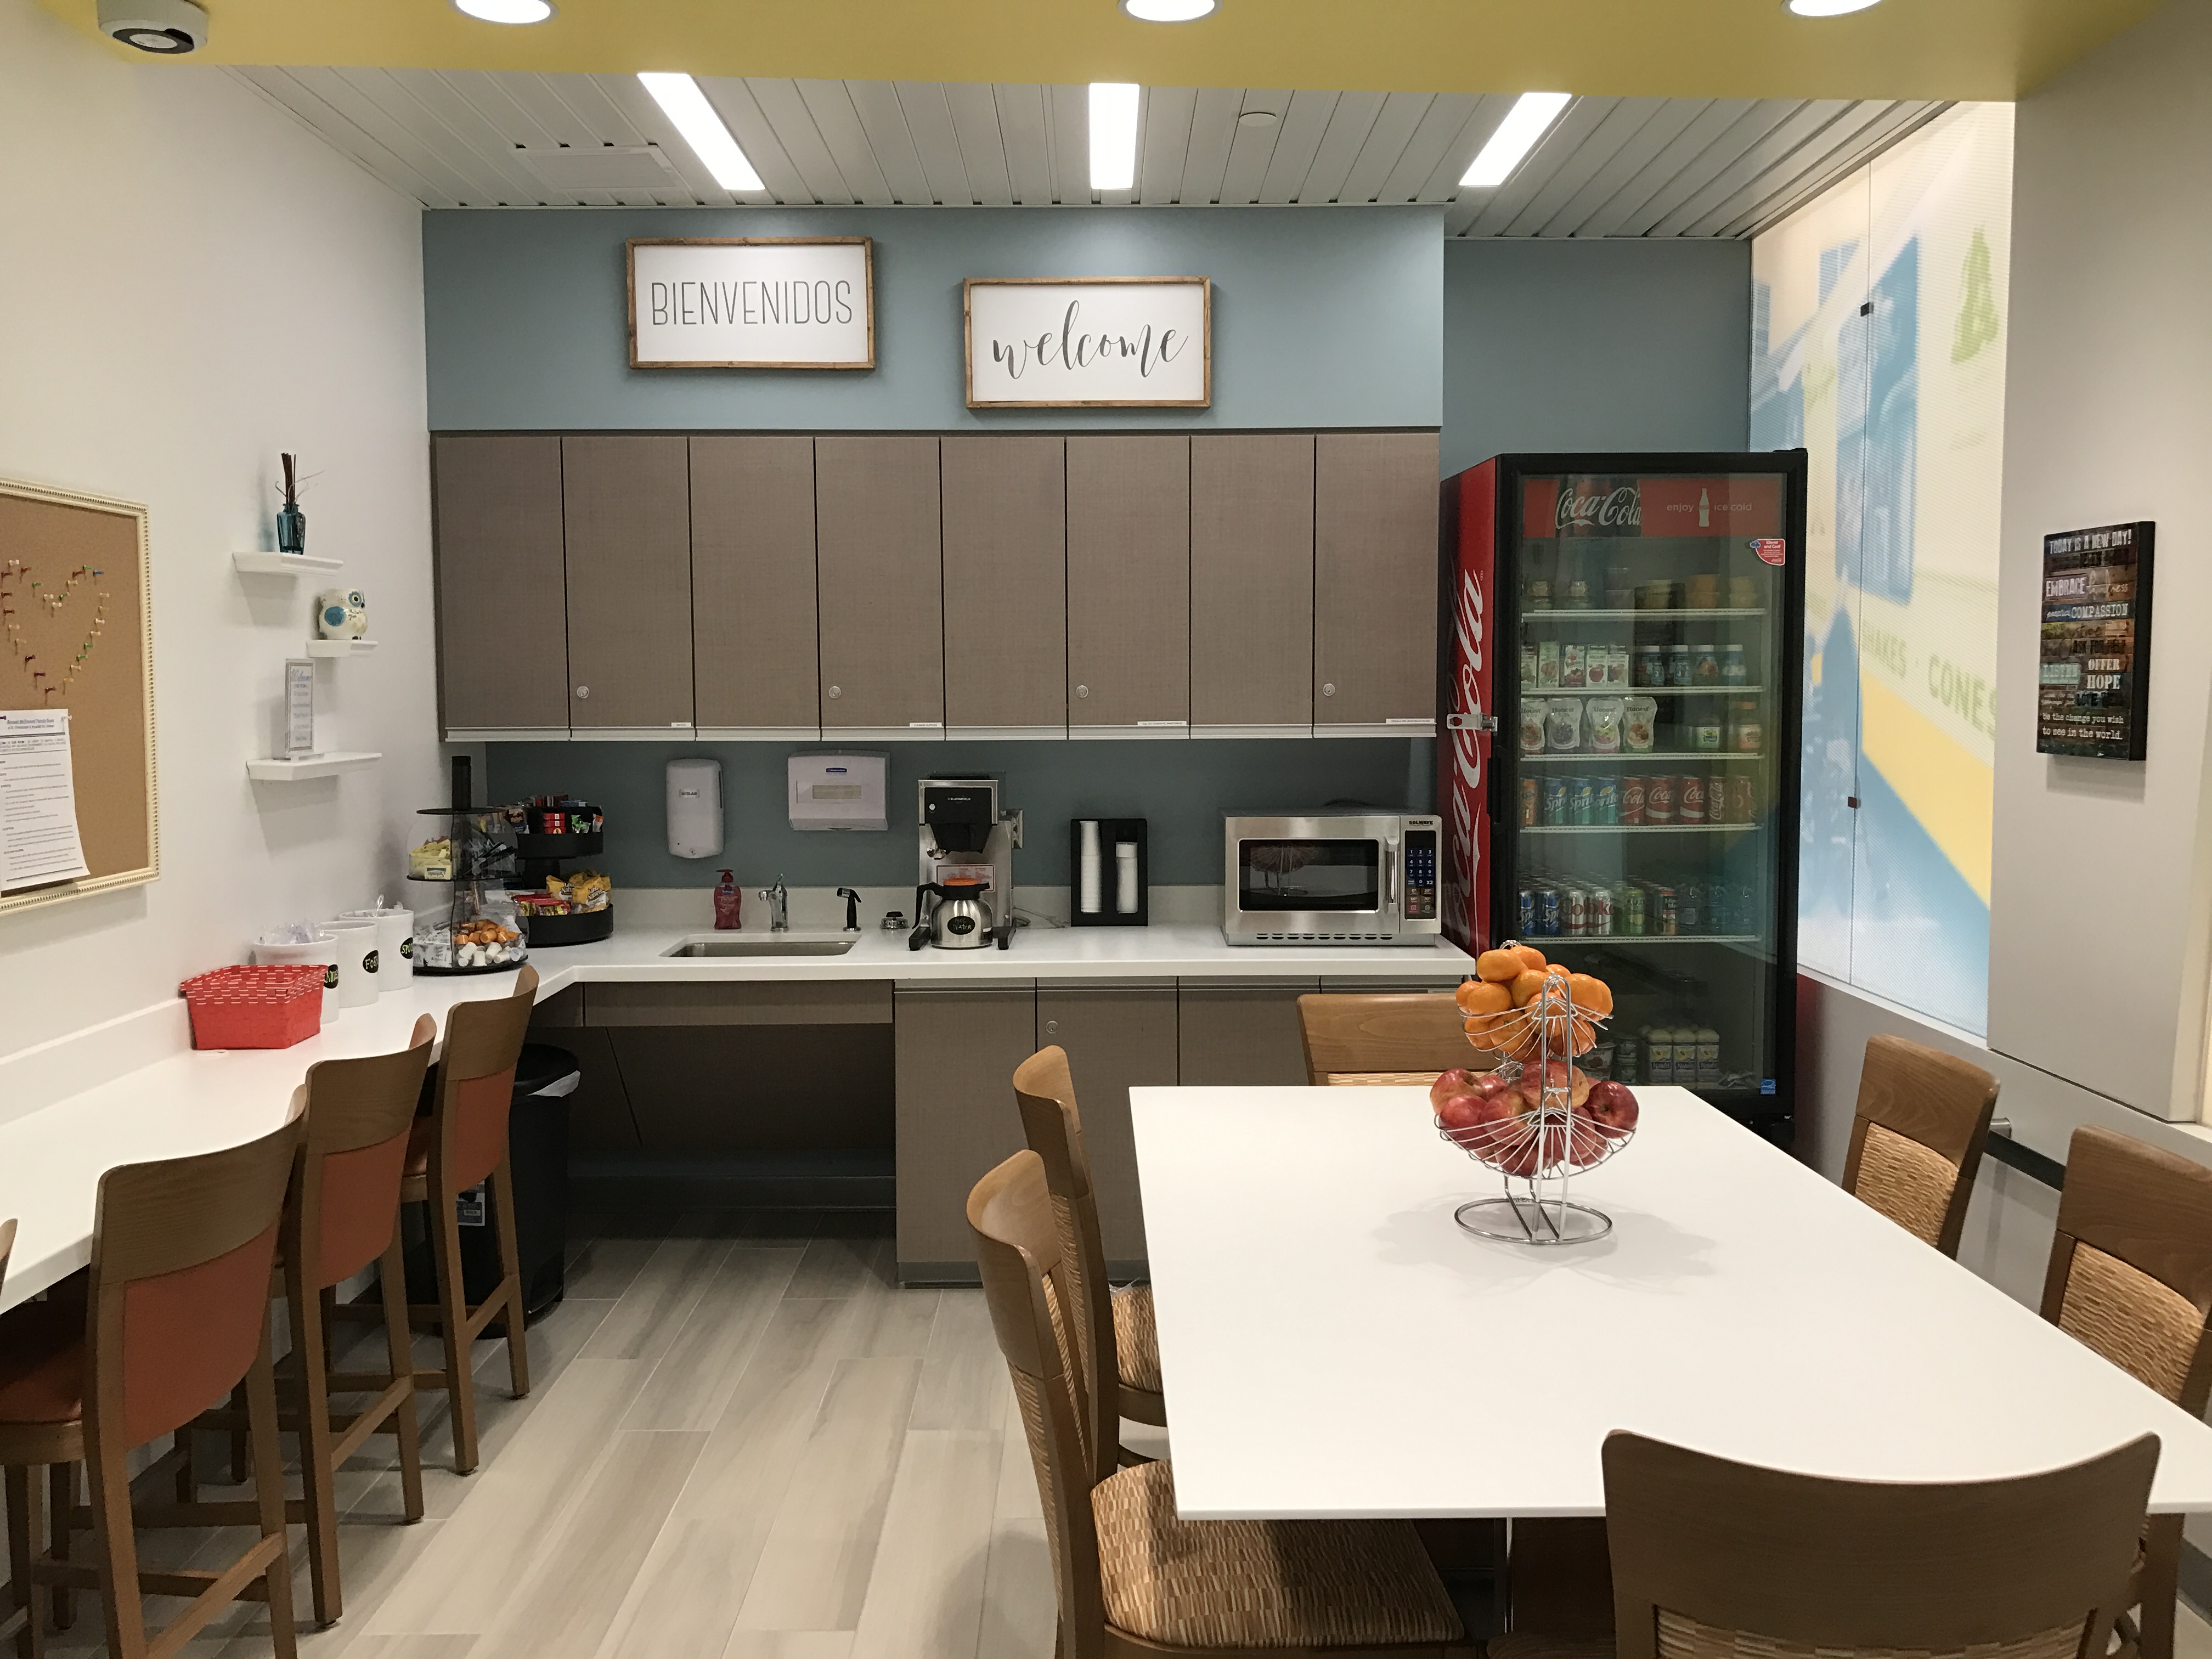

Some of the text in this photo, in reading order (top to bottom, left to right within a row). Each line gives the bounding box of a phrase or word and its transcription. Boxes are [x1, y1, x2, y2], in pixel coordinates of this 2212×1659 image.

[651, 279, 853, 325] BIENVENIDOS
[992, 300, 1189, 380] welcome
[1555, 487, 1641, 529] Coca-Cola
[1667, 503, 1752, 512] enjoy ice cold
[2050, 529, 2132, 554] TODAY IS A NEW DAY!
[2046, 578, 2085, 597] EMBRACE
[2072, 603, 2129, 619] COMPASSION
[2088, 658, 2120, 670] OFFER
[2086, 675, 2121, 689] HOPE
[2091, 715, 2106, 724] you
[2042, 726, 2051, 735] to
[2067, 728, 2076, 737] in
[2079, 729, 2094, 738] the
[2096, 730, 2123, 740] world.
[1445, 568, 1483, 960] oca-Cola
